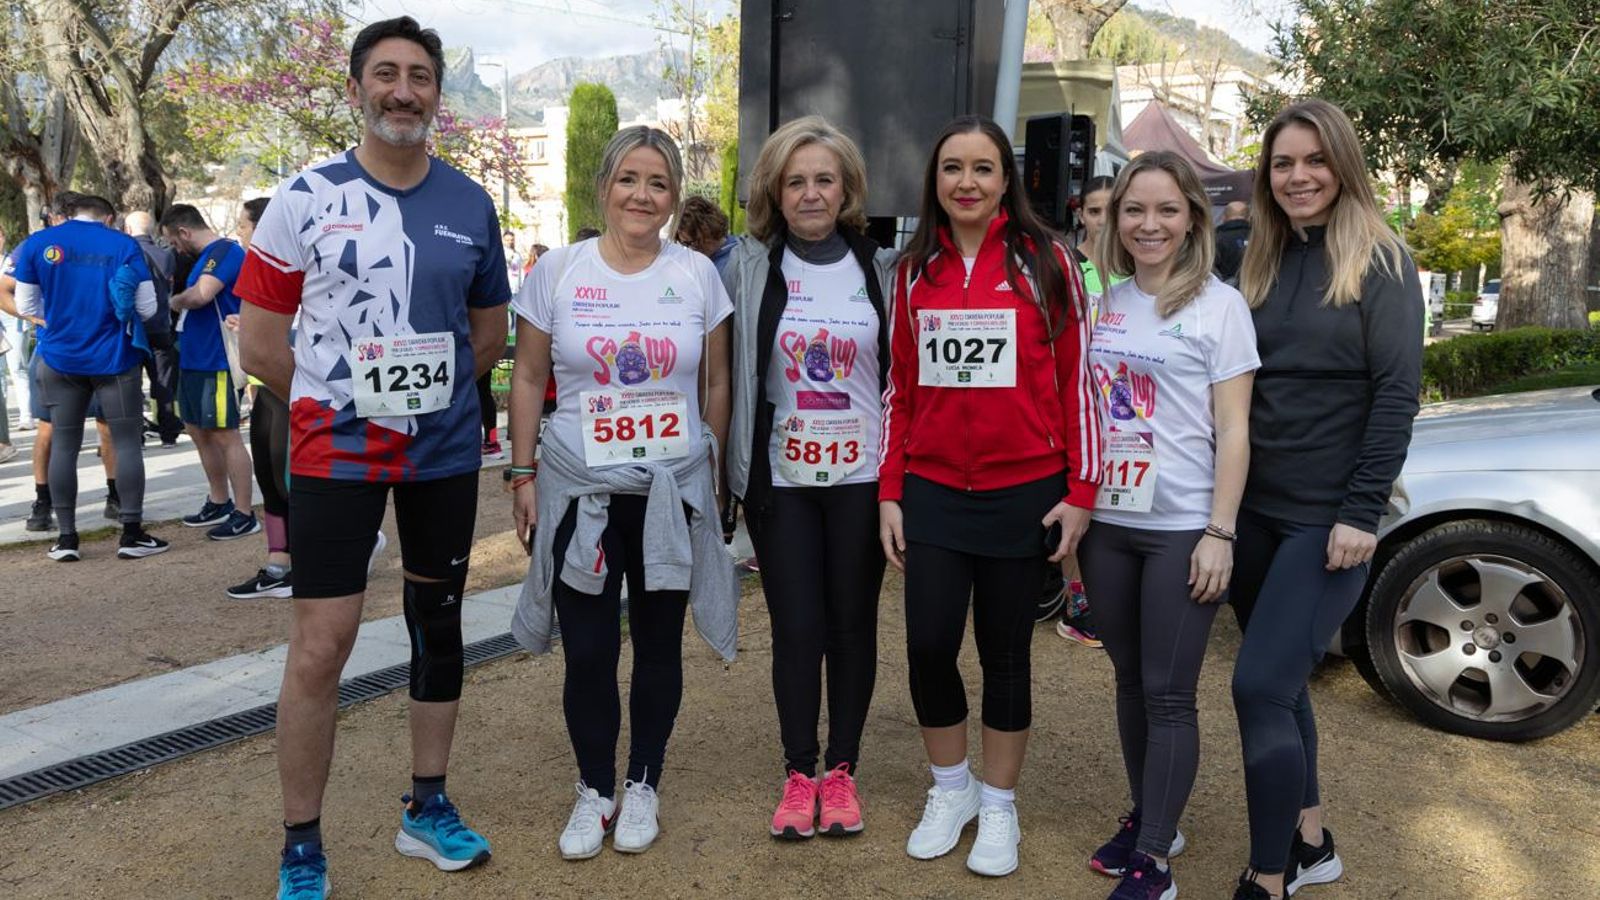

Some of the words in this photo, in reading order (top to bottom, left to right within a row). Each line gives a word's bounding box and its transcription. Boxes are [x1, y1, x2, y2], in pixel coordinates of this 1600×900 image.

[575, 286, 608, 301] XXVII
[926, 338, 1007, 364] 1027
[365, 361, 449, 393] 1234
[594, 413, 680, 443] 5812
[785, 438, 859, 465] 5813
